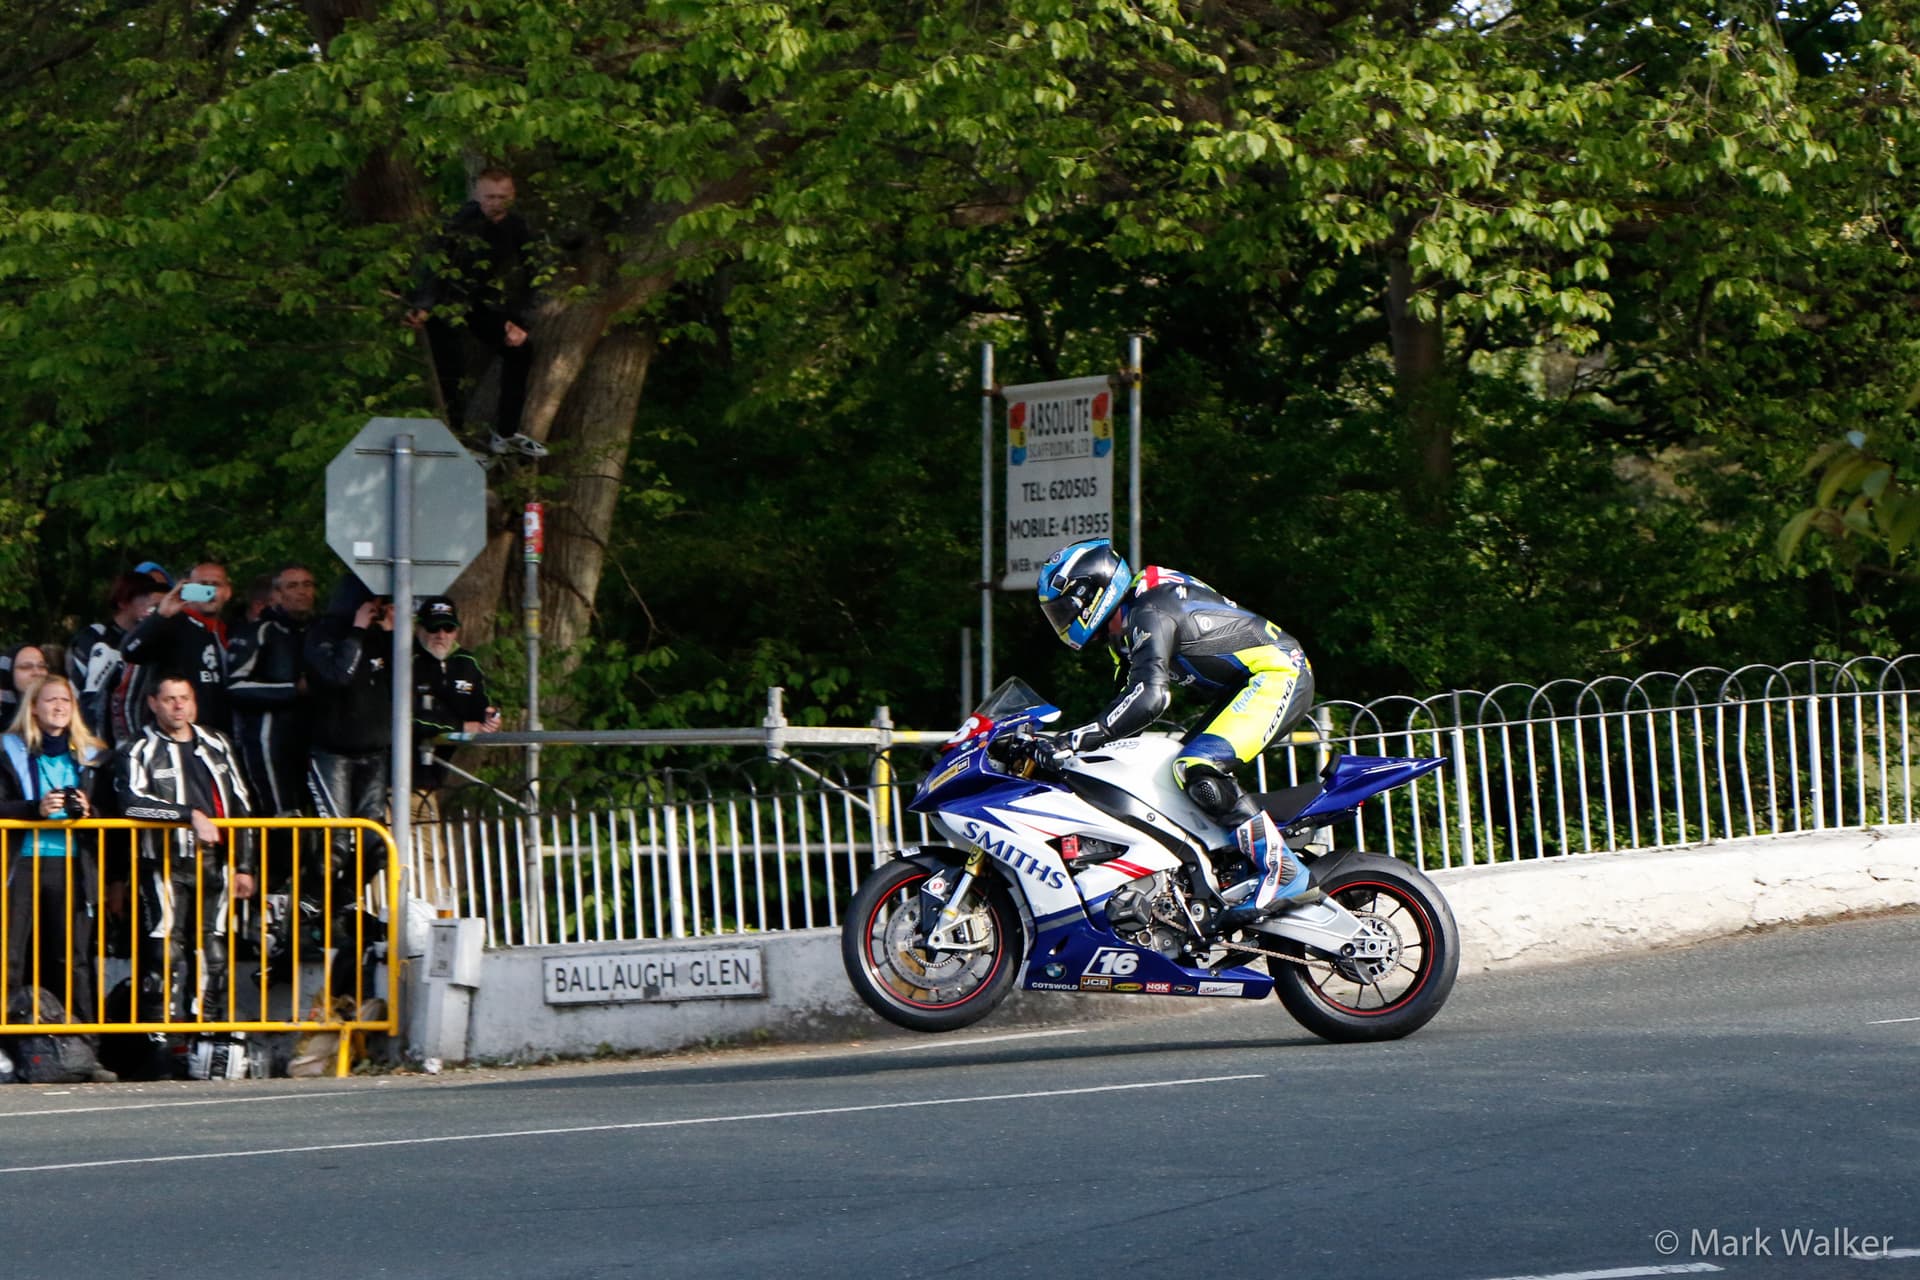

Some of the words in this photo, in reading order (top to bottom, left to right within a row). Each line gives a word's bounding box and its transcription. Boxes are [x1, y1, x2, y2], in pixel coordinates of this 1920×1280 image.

[1029, 398, 1089, 437] ABSOLUTE
[1022, 481, 1046, 502] TEL:
[1049, 477, 1097, 500] 620505
[1009, 517, 1060, 539] MOBILE:
[1061, 513, 1109, 535] 413955
[962, 821, 1067, 889] SMITHS
[556, 962, 676, 993] BALLAUGH
[690, 958, 750, 985] GLEN
[1099, 952, 1139, 976] 16
[1031, 981, 1079, 991] COTSWOLD
[1083, 978, 1109, 986] JCB
